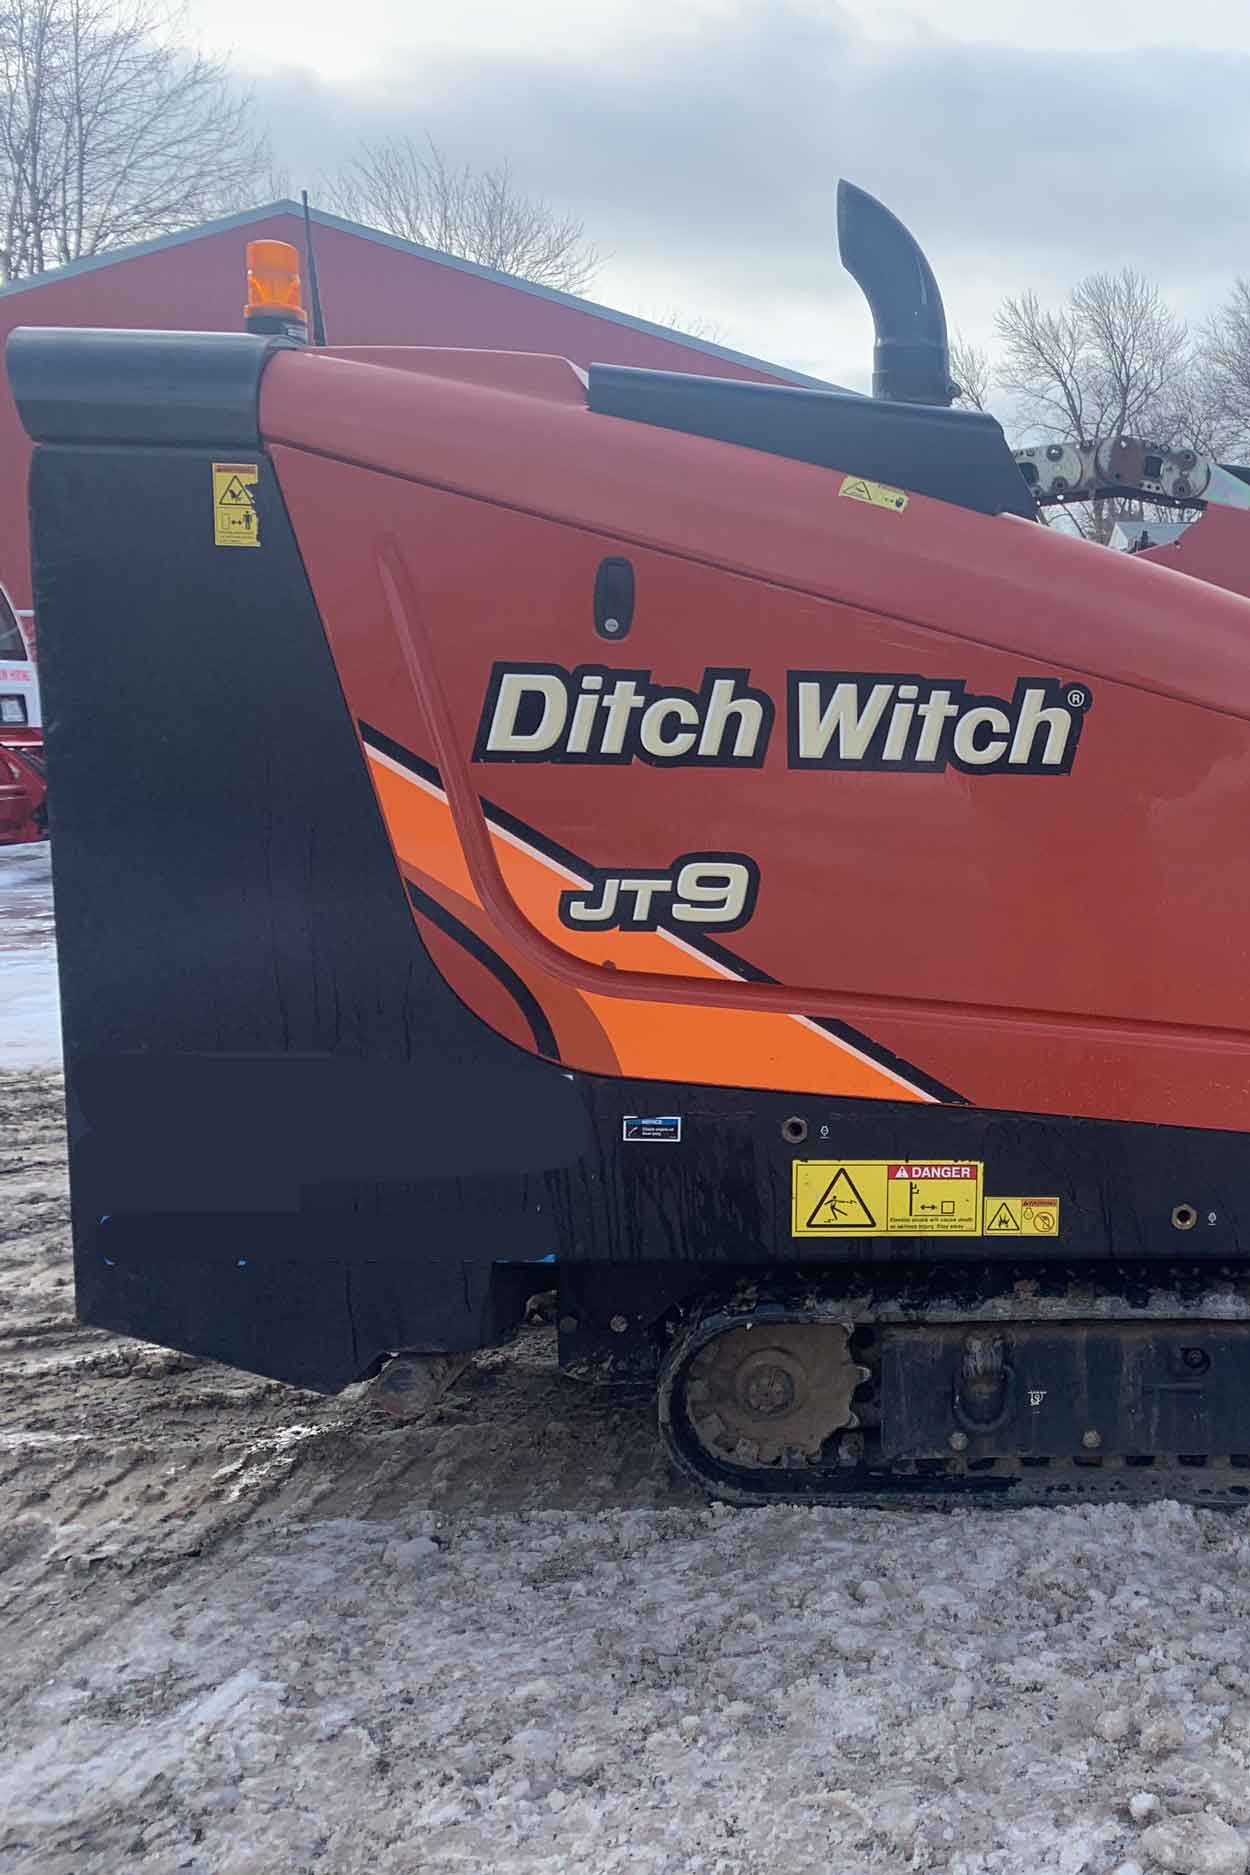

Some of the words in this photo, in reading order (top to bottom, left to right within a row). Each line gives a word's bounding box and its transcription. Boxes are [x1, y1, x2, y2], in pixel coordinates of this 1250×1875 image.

[487, 673, 764, 758] Ditch
[569, 862, 749, 922] JT9
[911, 1166, 971, 1178] DANGER
